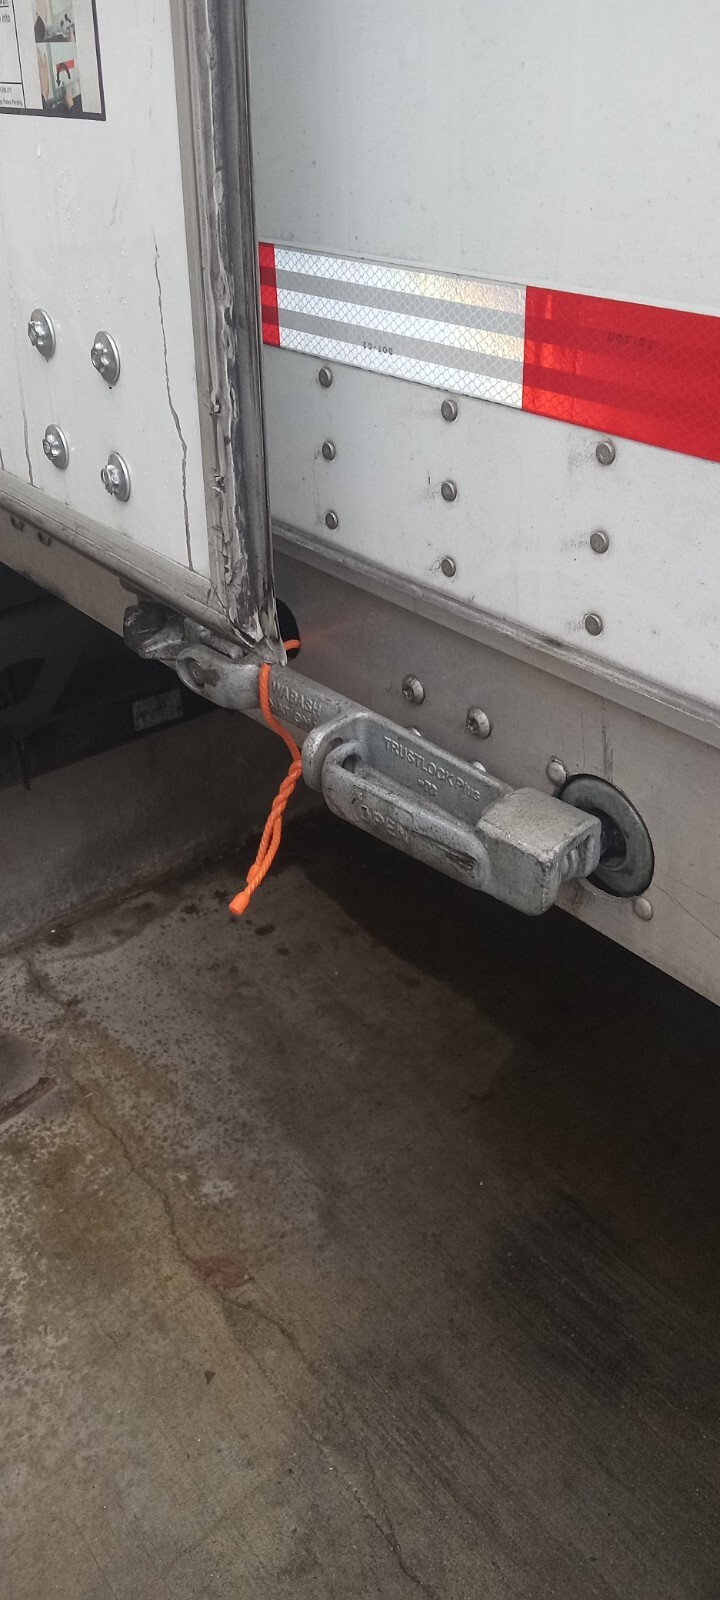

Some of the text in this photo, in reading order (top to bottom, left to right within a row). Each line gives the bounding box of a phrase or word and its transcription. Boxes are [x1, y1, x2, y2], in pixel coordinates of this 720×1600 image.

[271, 680, 322, 717] WABASH
[384, 735, 481, 801] TRUSTLOCK Plus
[360, 804, 410, 844] OPEN
